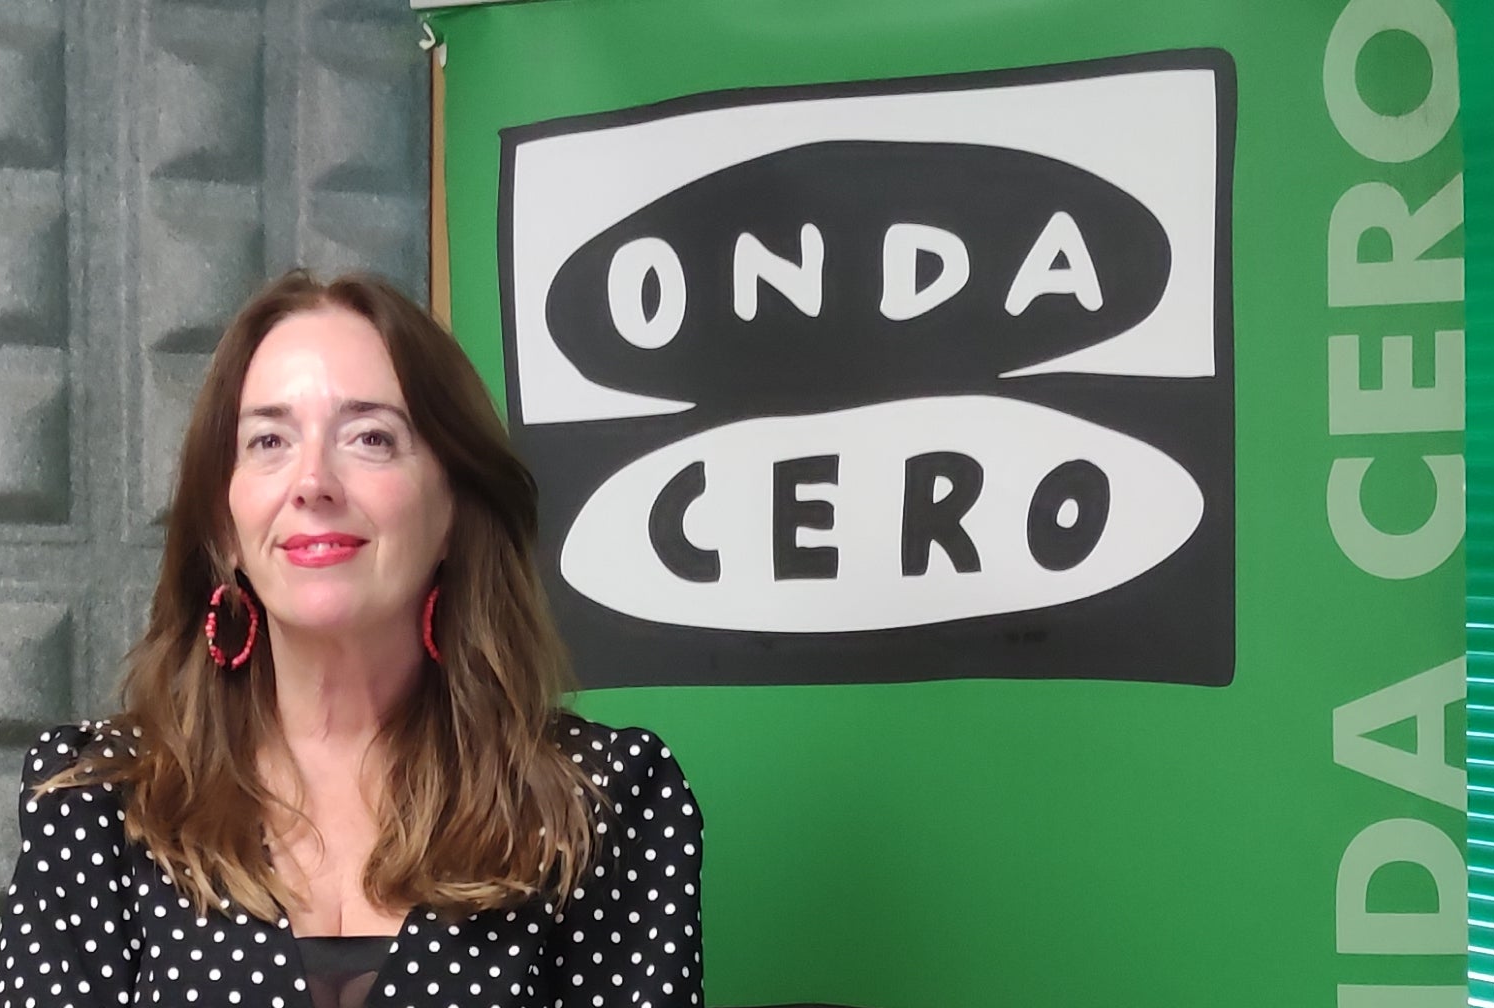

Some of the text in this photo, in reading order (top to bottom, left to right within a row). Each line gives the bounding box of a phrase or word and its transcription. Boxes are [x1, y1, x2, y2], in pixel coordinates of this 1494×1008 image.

[607, 211, 1102, 348] ONDA
[1321, 0, 1467, 580] CERO
[647, 450, 1111, 583] CERO
